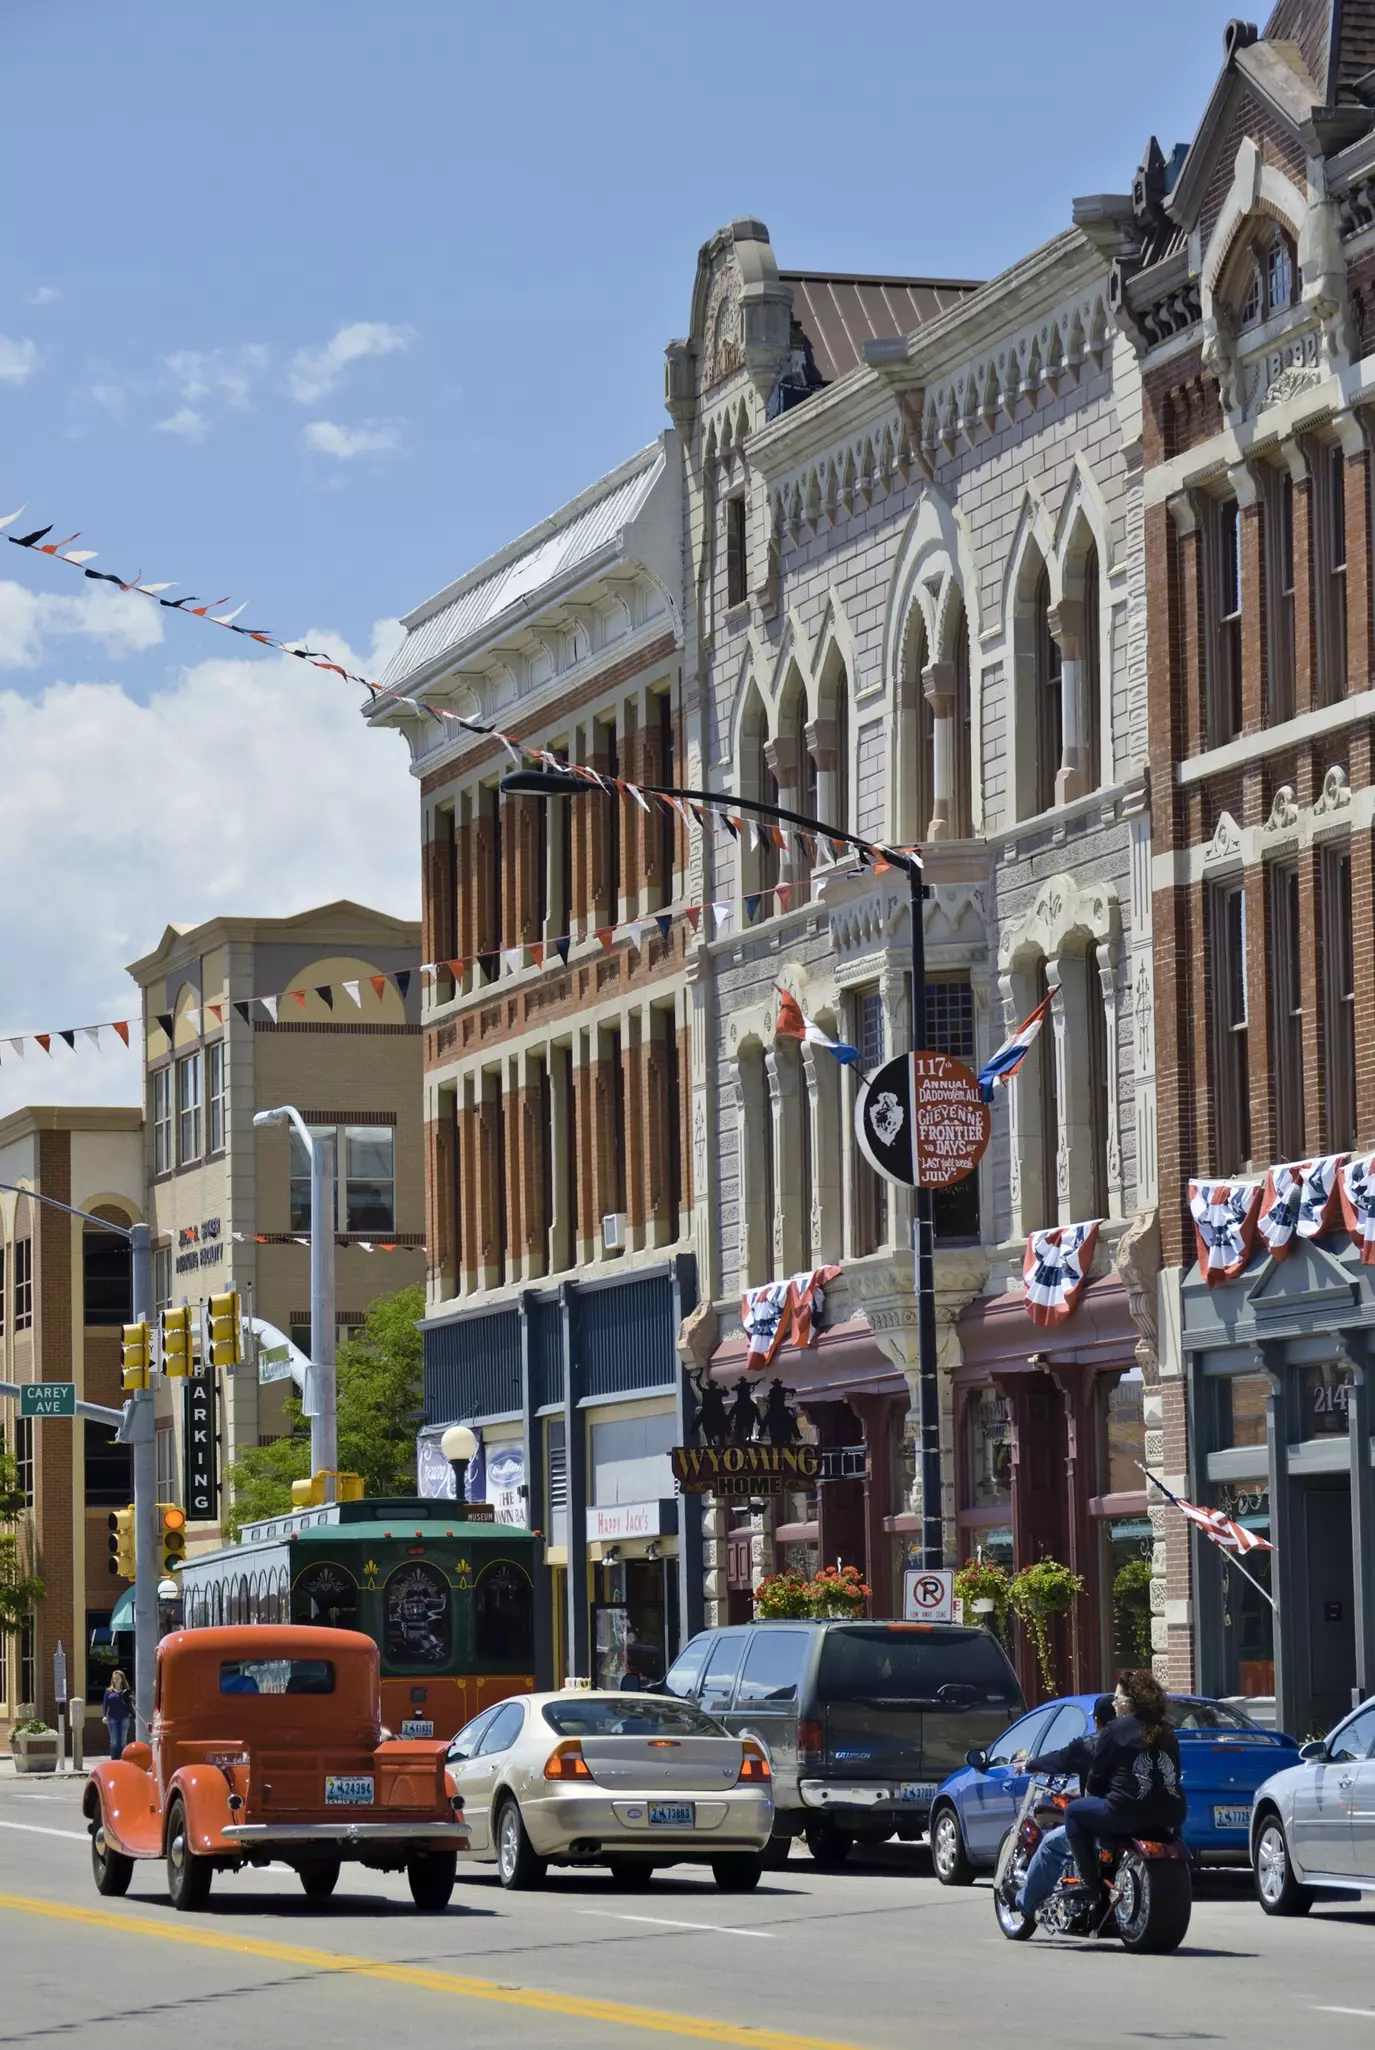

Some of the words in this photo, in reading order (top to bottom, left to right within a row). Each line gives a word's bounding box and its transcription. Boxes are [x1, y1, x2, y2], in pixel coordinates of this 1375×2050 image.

[916, 1057, 953, 1077] 117th
[922, 1078, 969, 1089] ANNUAL
[919, 1088, 948, 1103] DADDY
[966, 1088, 982, 1103] ALL
[917, 1105, 984, 1126] CHEYENNE
[919, 1125, 984, 1140] FRONTIER
[935, 1140, 967, 1156] DAYS
[921, 1157, 940, 1169] LAST
[921, 1171, 950, 1181] JULY
[27, 1387, 68, 1399] CAREY
[1314, 1384, 1347, 1413] 214
[36, 1401, 61, 1412] AVE
[193, 1364, 209, 1508] PARKING
[678, 1446, 819, 1478] WYOMING
[718, 1476, 782, 1496] HOME
[467, 1512, 493, 1521] MUSEUM
[345, 1782, 371, 1795] 24394
[1233, 1811, 1252, 1822] 7726
